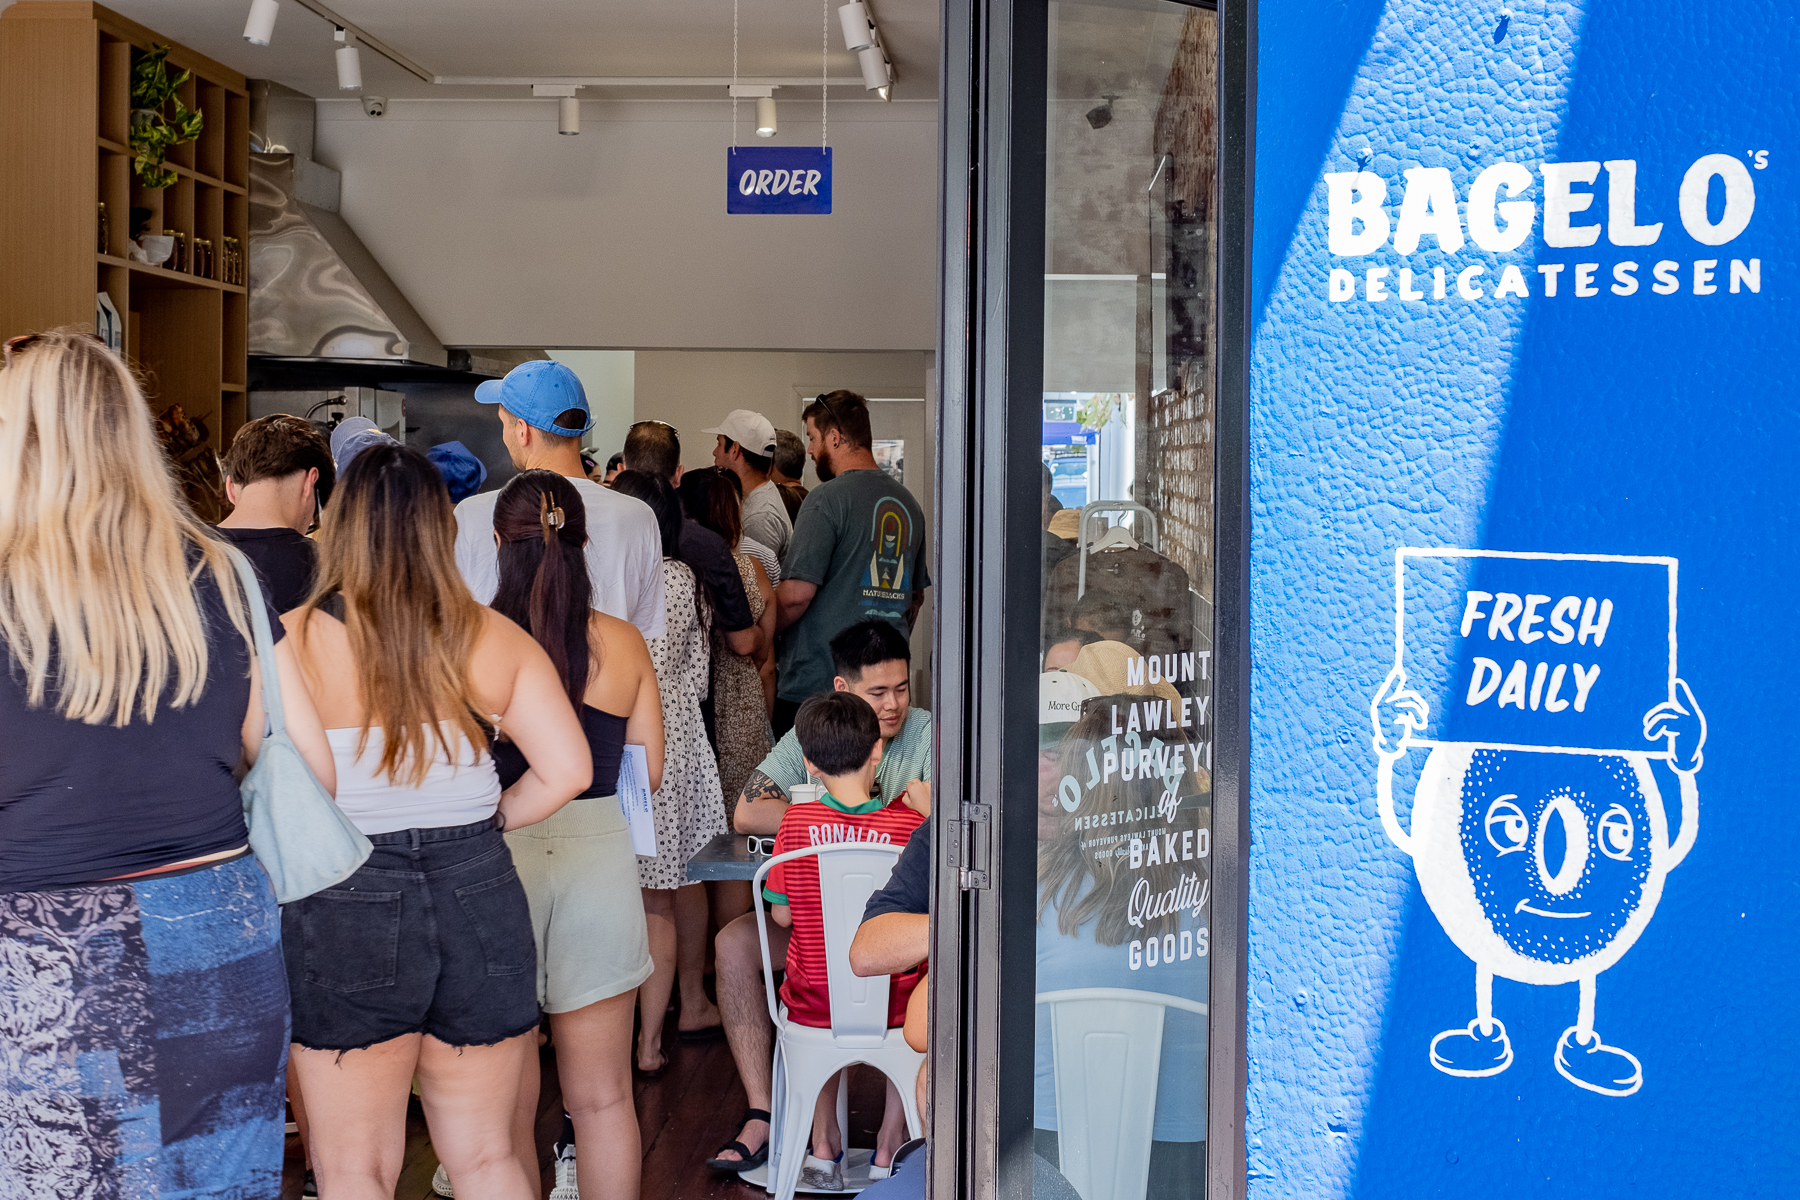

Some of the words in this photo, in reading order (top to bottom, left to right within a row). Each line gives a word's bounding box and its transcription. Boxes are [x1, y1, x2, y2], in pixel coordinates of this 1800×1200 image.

[739, 169, 822, 196] ORDER
[1323, 159, 1664, 256] BAGEL
[1329, 258, 1761, 302] DELICATESSEN
[1460, 590, 1614, 647] FRESH
[1127, 651, 1211, 687] MOUNT
[1466, 656, 1601, 713] DAILY
[1047, 700, 1071, 711] More
[1111, 696, 1210, 735] LAWLEY
[1158, 781, 1183, 824] of
[808, 823, 891, 847] RONALDO
[1129, 828, 1210, 870] BAKED
[1127, 871, 1210, 929] Quality
[1128, 927, 1209, 971] GOODS
